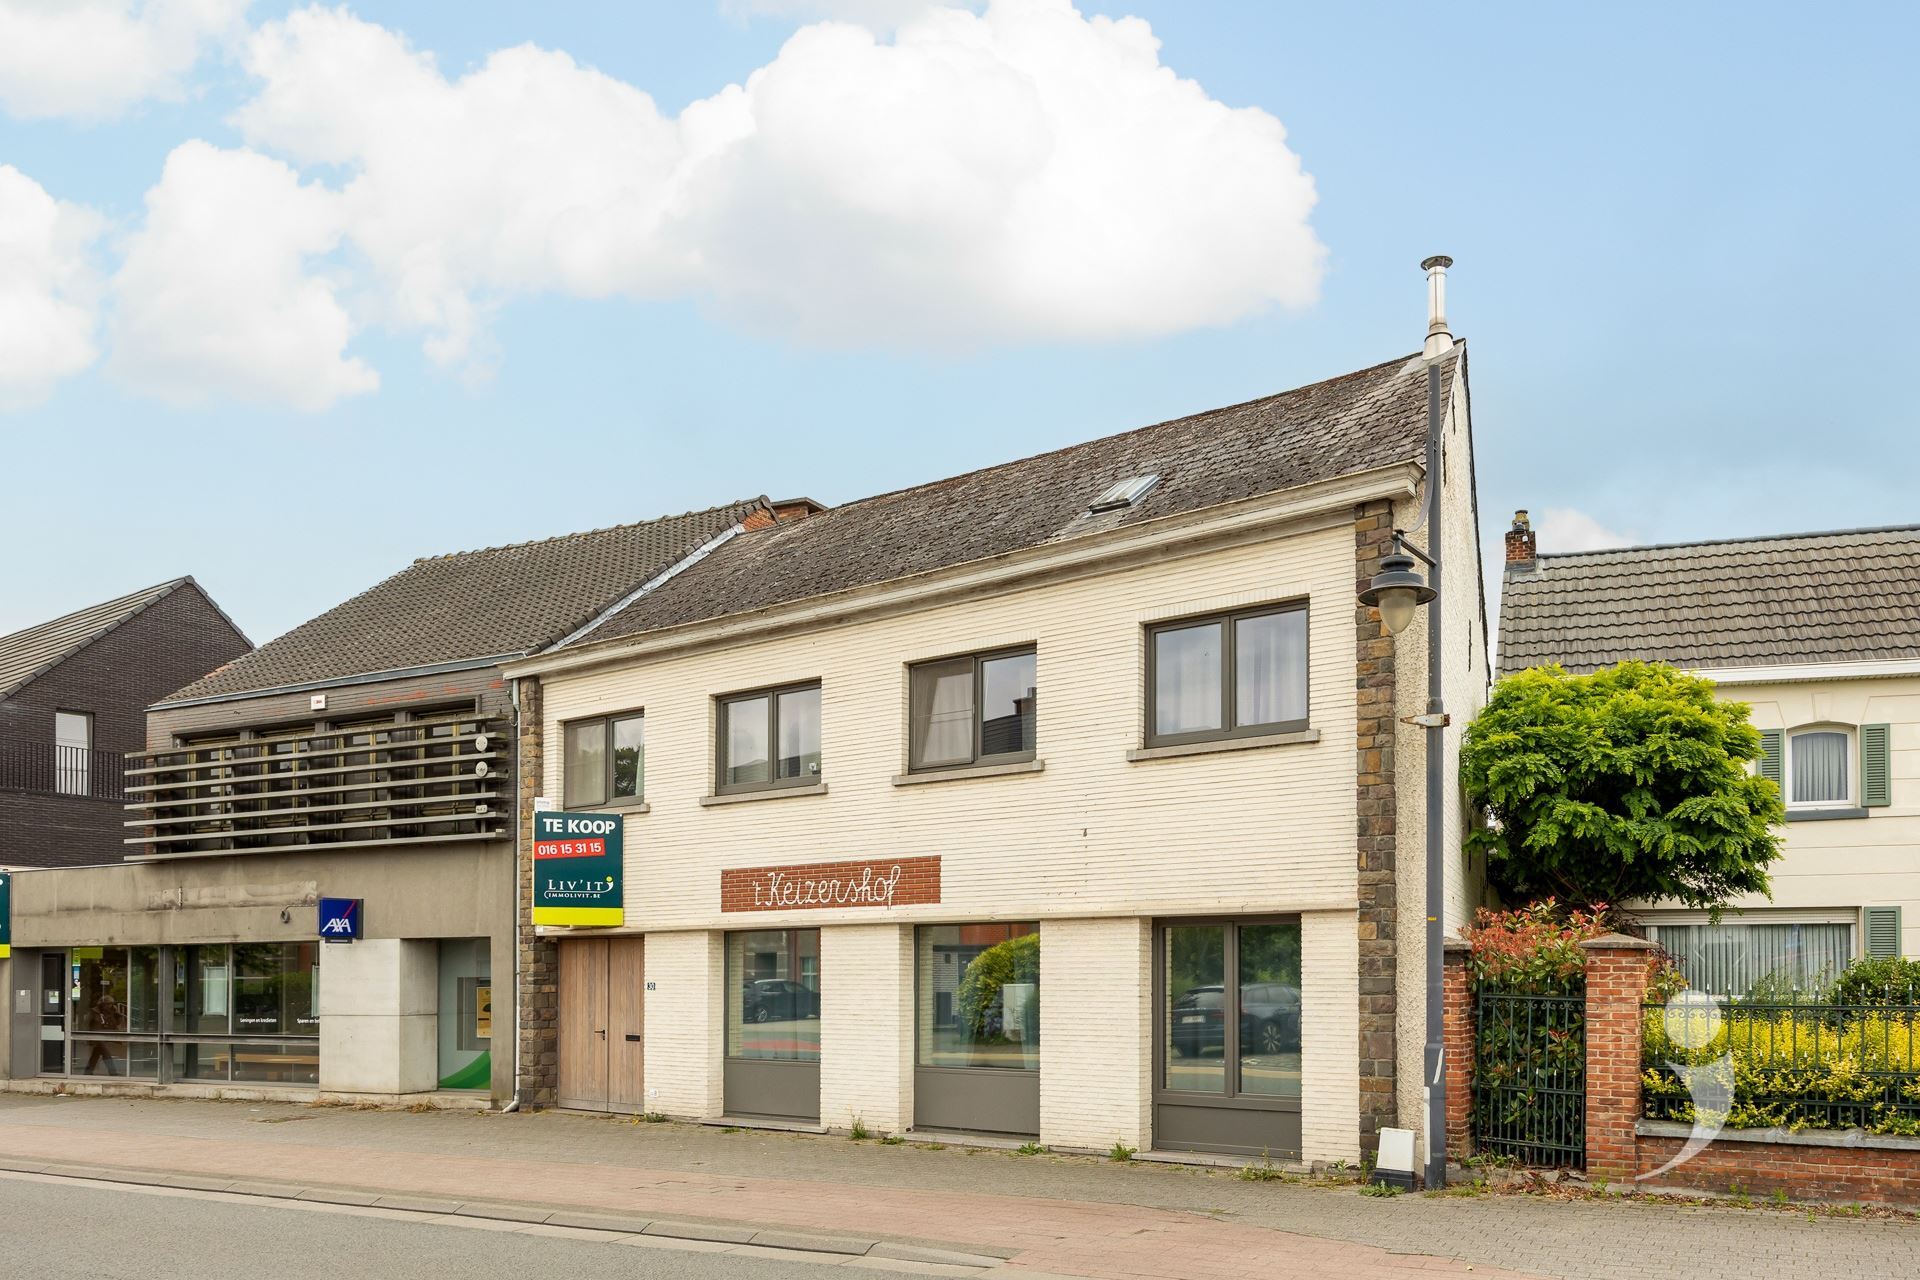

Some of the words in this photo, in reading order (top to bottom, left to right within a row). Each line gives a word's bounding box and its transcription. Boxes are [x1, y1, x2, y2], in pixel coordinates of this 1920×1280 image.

[542, 818, 564, 833] TE
[567, 819, 616, 835] KOOP
[538, 844, 558, 856] 016
[560, 843, 573, 855] 15
[575, 843, 587, 854] 31
[589, 842, 602, 853] 15
[764, 865, 901, 908] Keizershof
[321, 918, 352, 933] AXA
